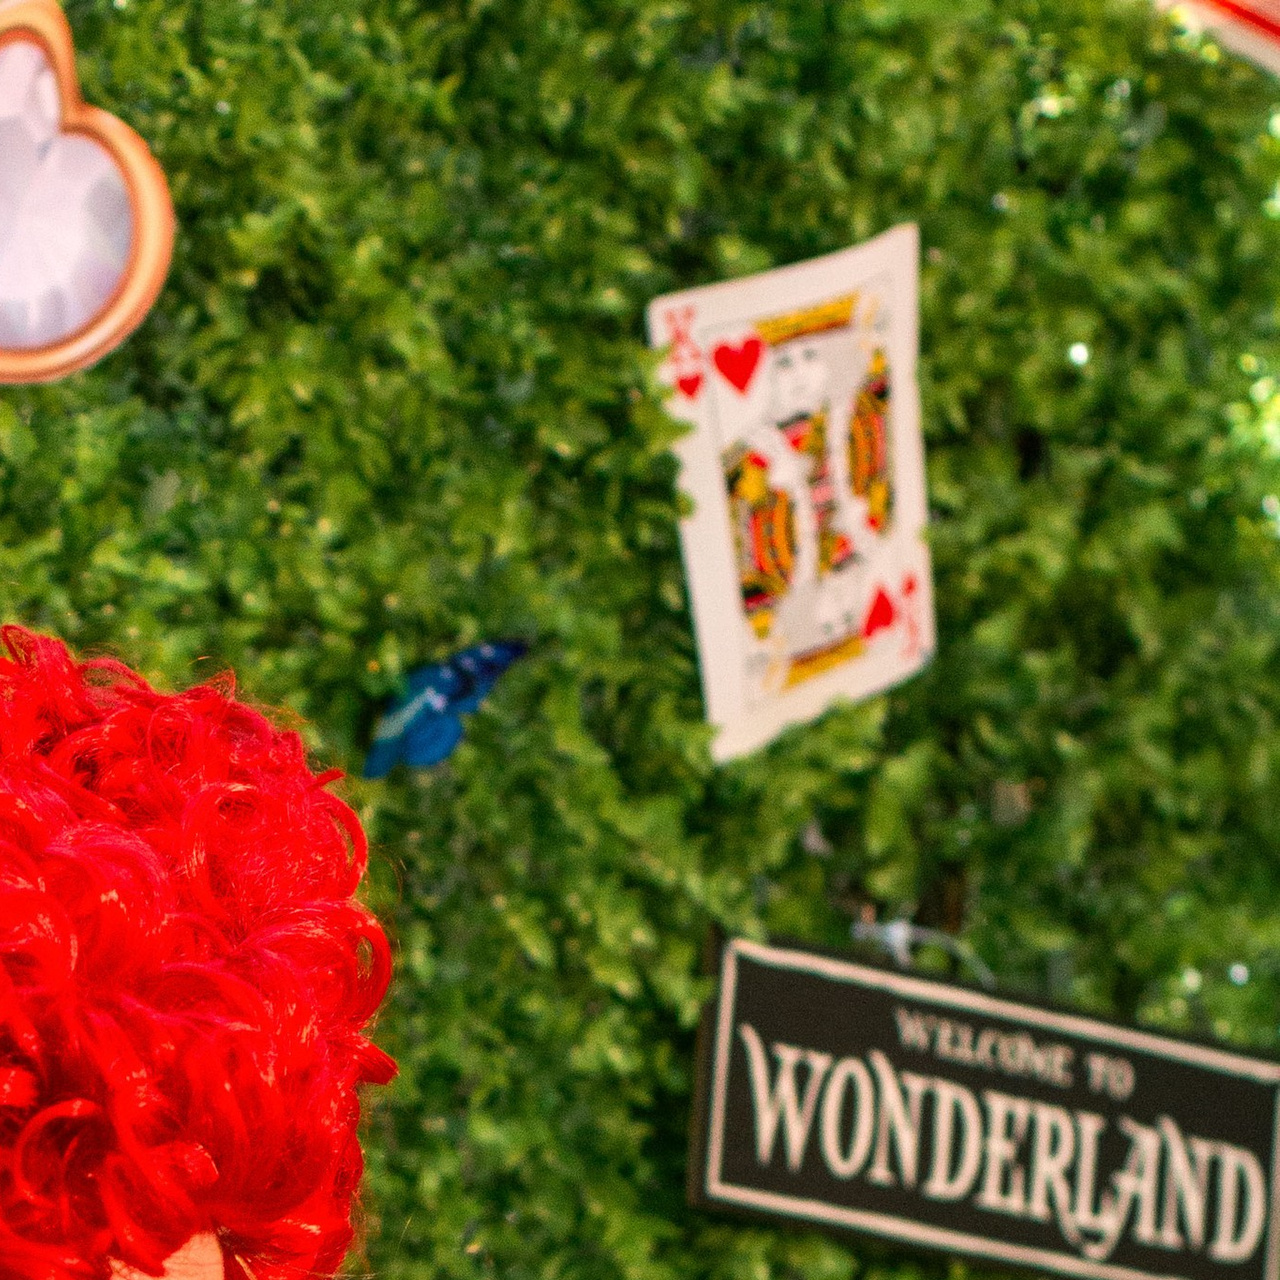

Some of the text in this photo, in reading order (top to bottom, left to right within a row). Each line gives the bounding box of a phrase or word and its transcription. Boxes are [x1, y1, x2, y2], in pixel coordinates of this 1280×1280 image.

[895, 1008, 1135, 1099] WELCOME TO
[740, 1023, 1266, 1264] WONDERLAND
